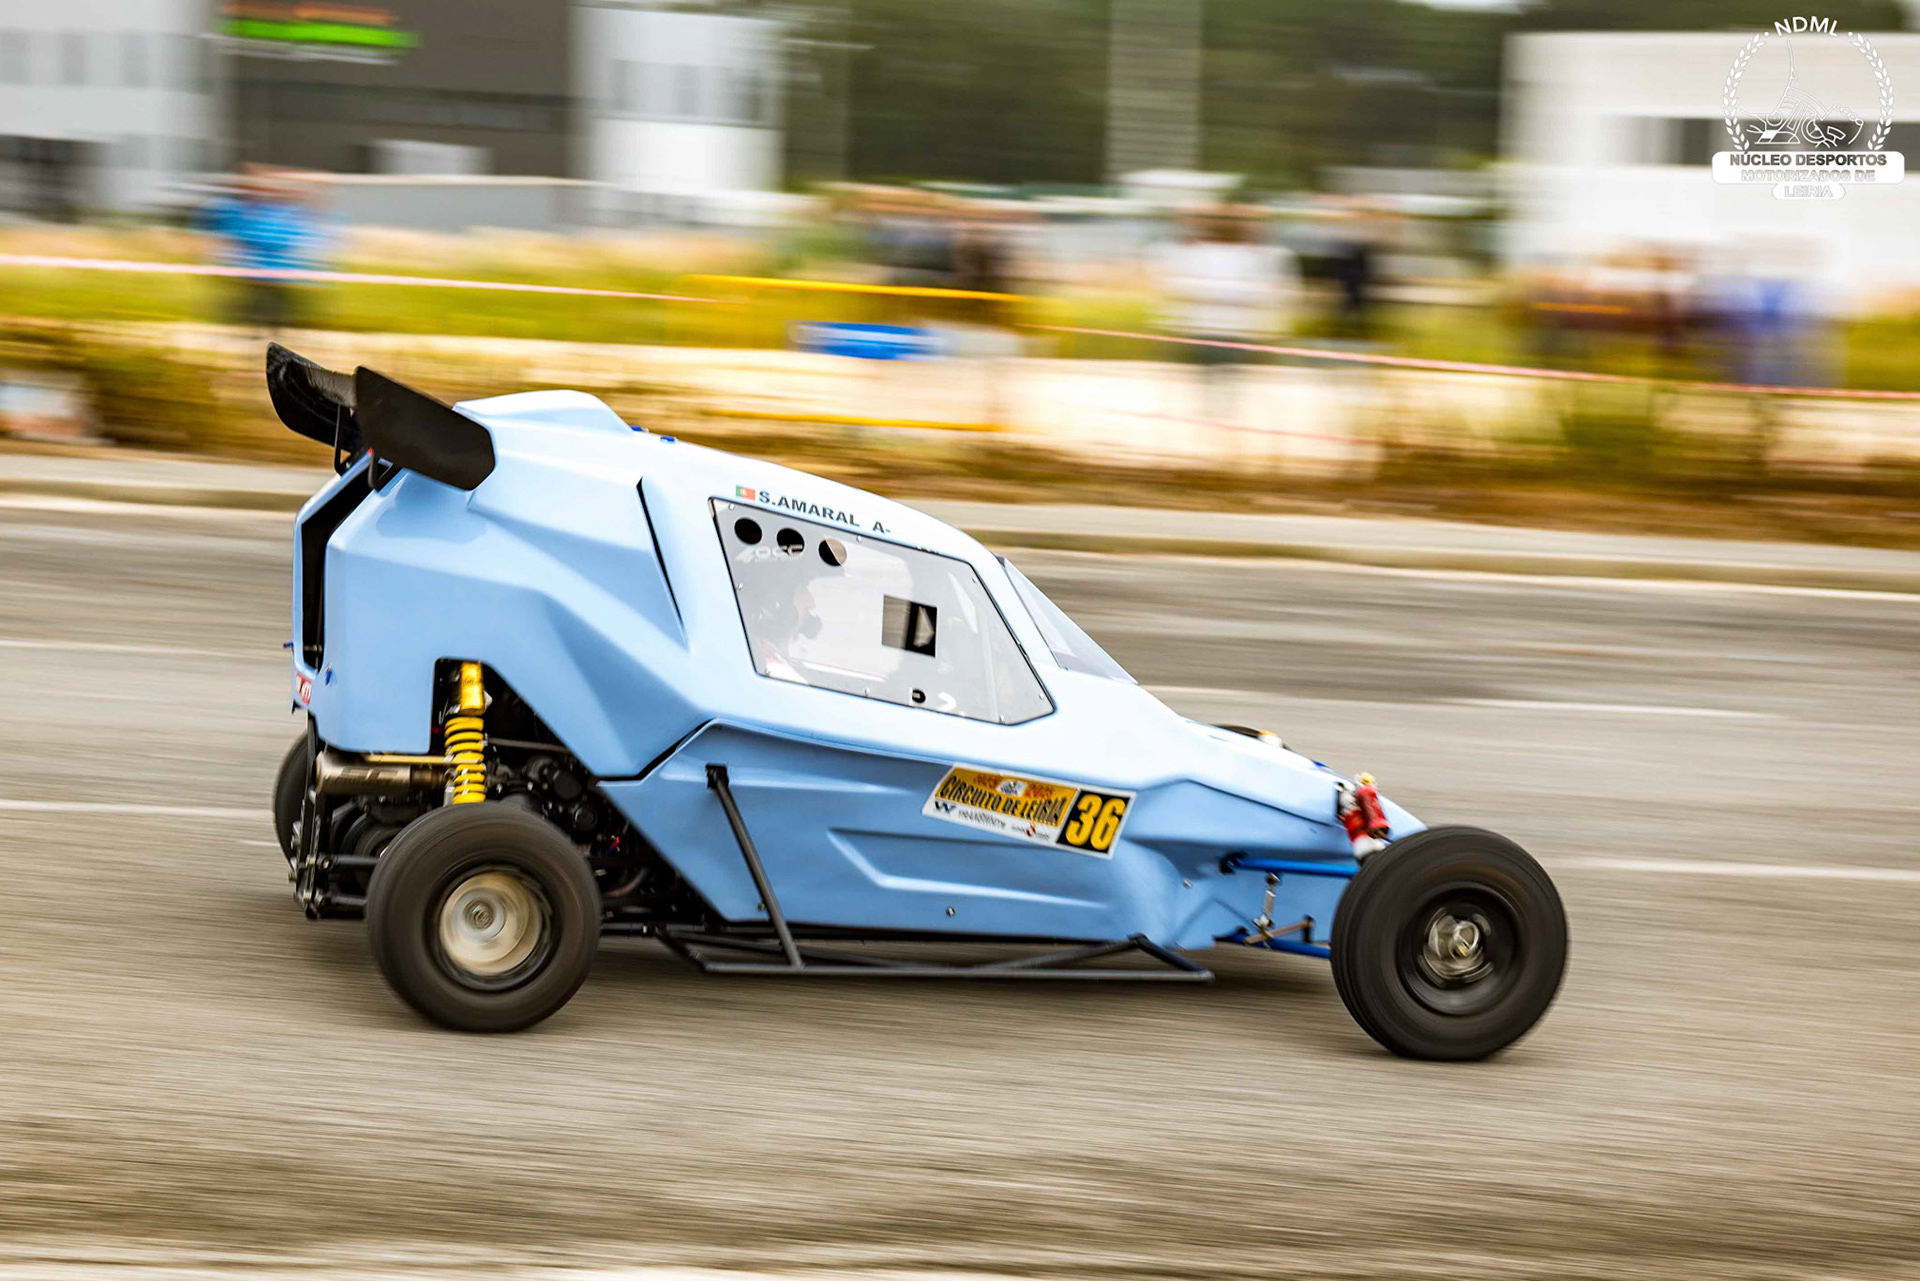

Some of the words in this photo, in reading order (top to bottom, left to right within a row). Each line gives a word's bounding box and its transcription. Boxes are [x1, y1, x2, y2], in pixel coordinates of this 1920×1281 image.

[759, 491, 860, 526] S.AMARAL
[940, 776, 1002, 811] CIRCUITO
[1002, 797, 1021, 815] DE
[1020, 797, 1067, 825] LEIRIA
[1066, 794, 1126, 851] 36
